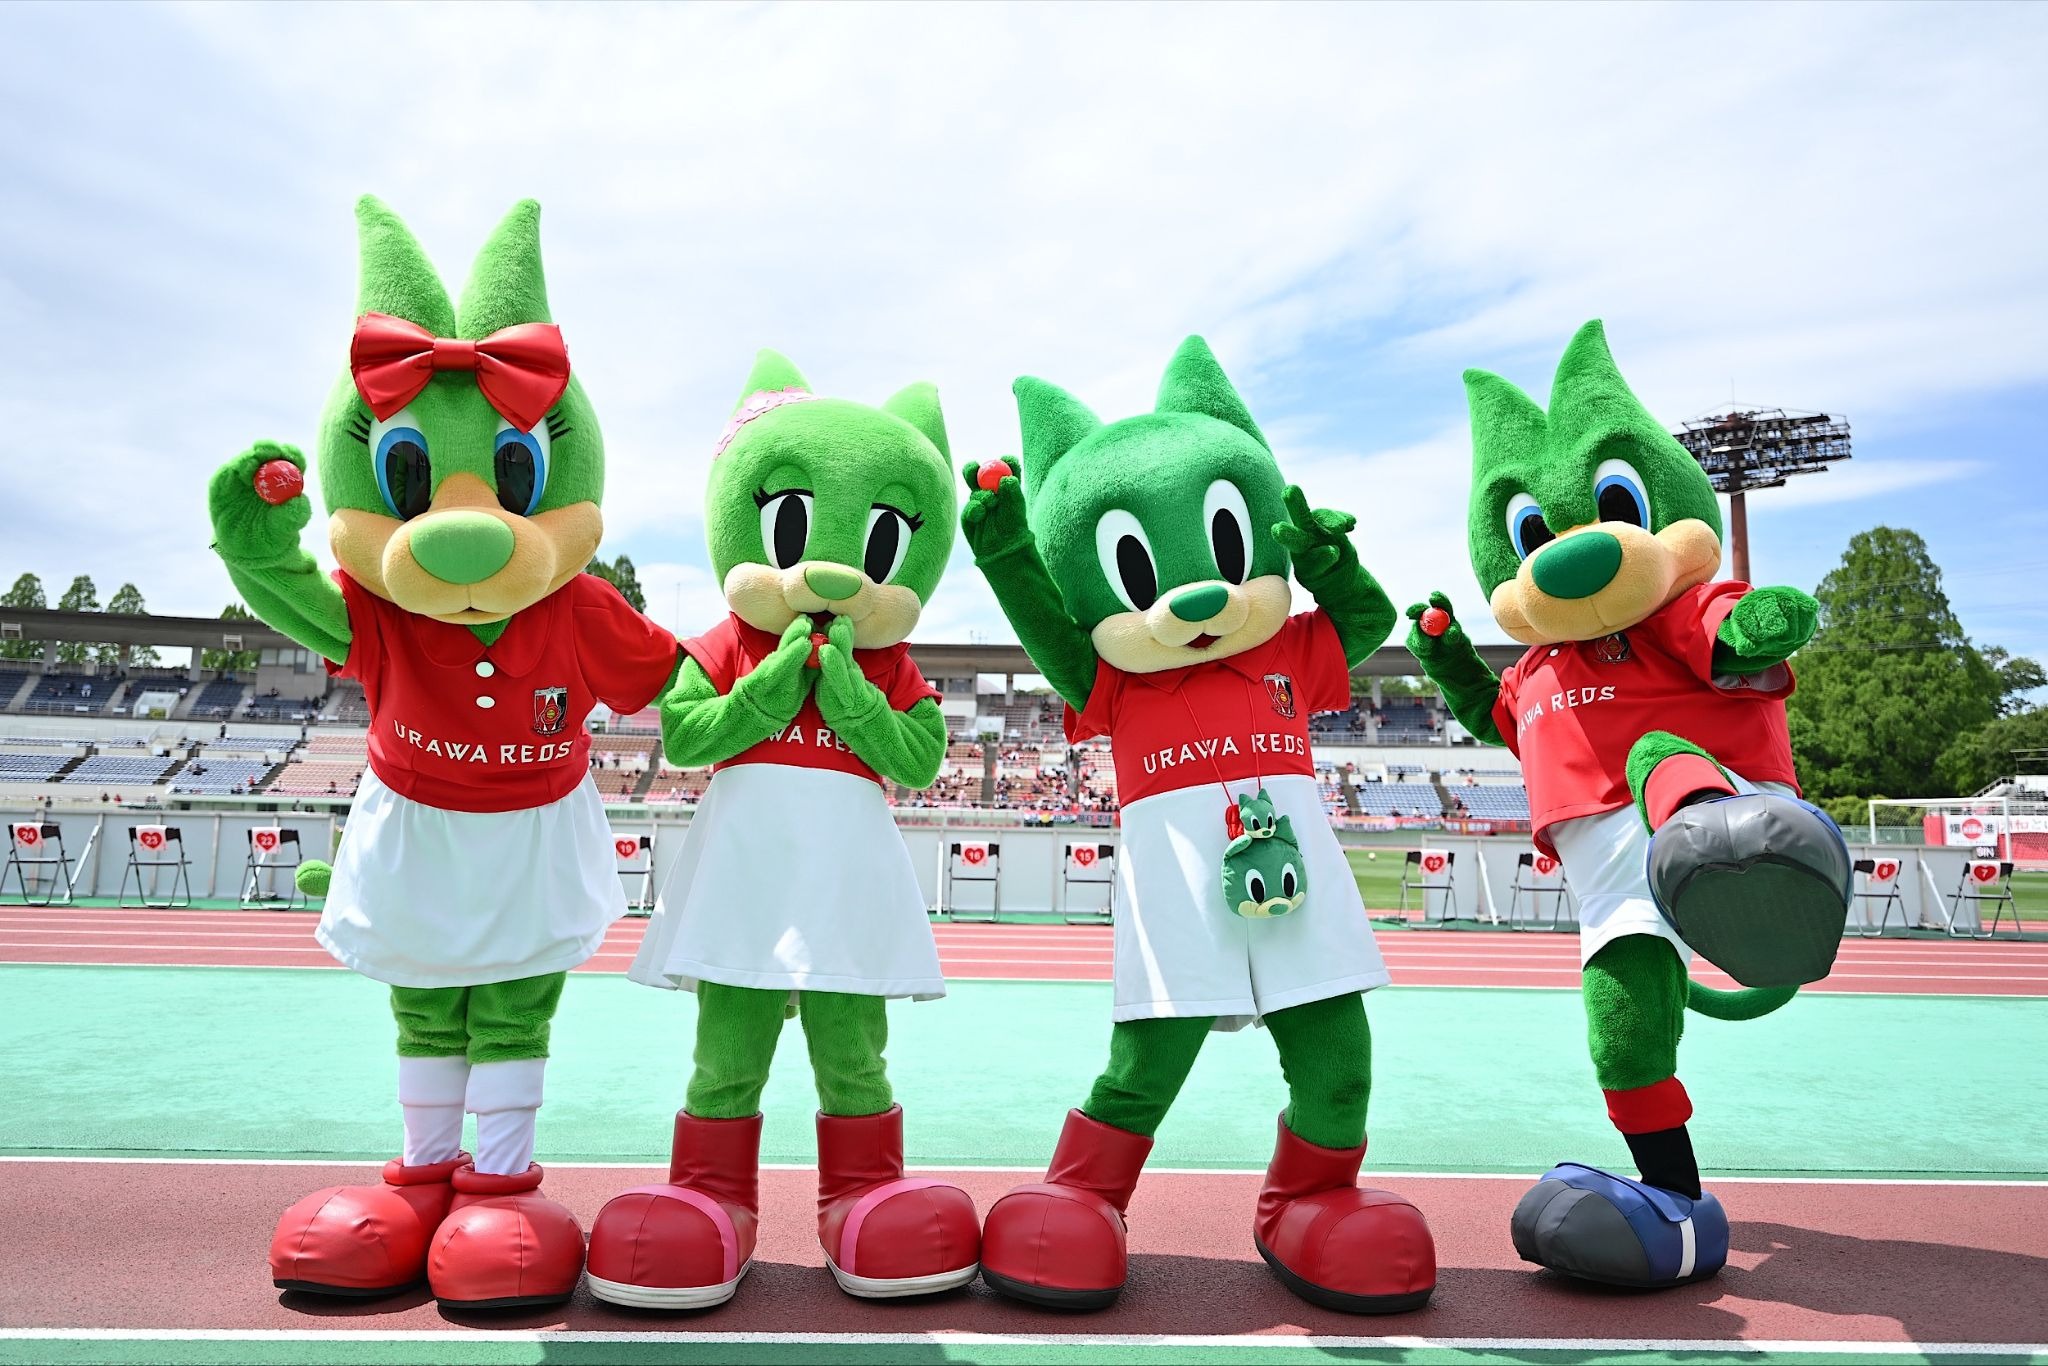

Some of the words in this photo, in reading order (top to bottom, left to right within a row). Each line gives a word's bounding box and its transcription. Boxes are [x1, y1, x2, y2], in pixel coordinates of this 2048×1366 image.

[1551, 686, 1616, 712] REDS
[394, 719, 489, 764] URAWA
[501, 741, 573, 764] REDS
[816, 728, 855, 755] RE
[1143, 736, 1239, 774] URAWA
[1251, 733, 1304, 755] REDS
[22, 831, 35, 841] 24
[145, 836, 159, 845] 23
[260, 836, 274, 846] 22
[620, 844, 633, 854] 19
[1541, 860, 1551, 870] 11
[1981, 869, 1989, 878] 7
